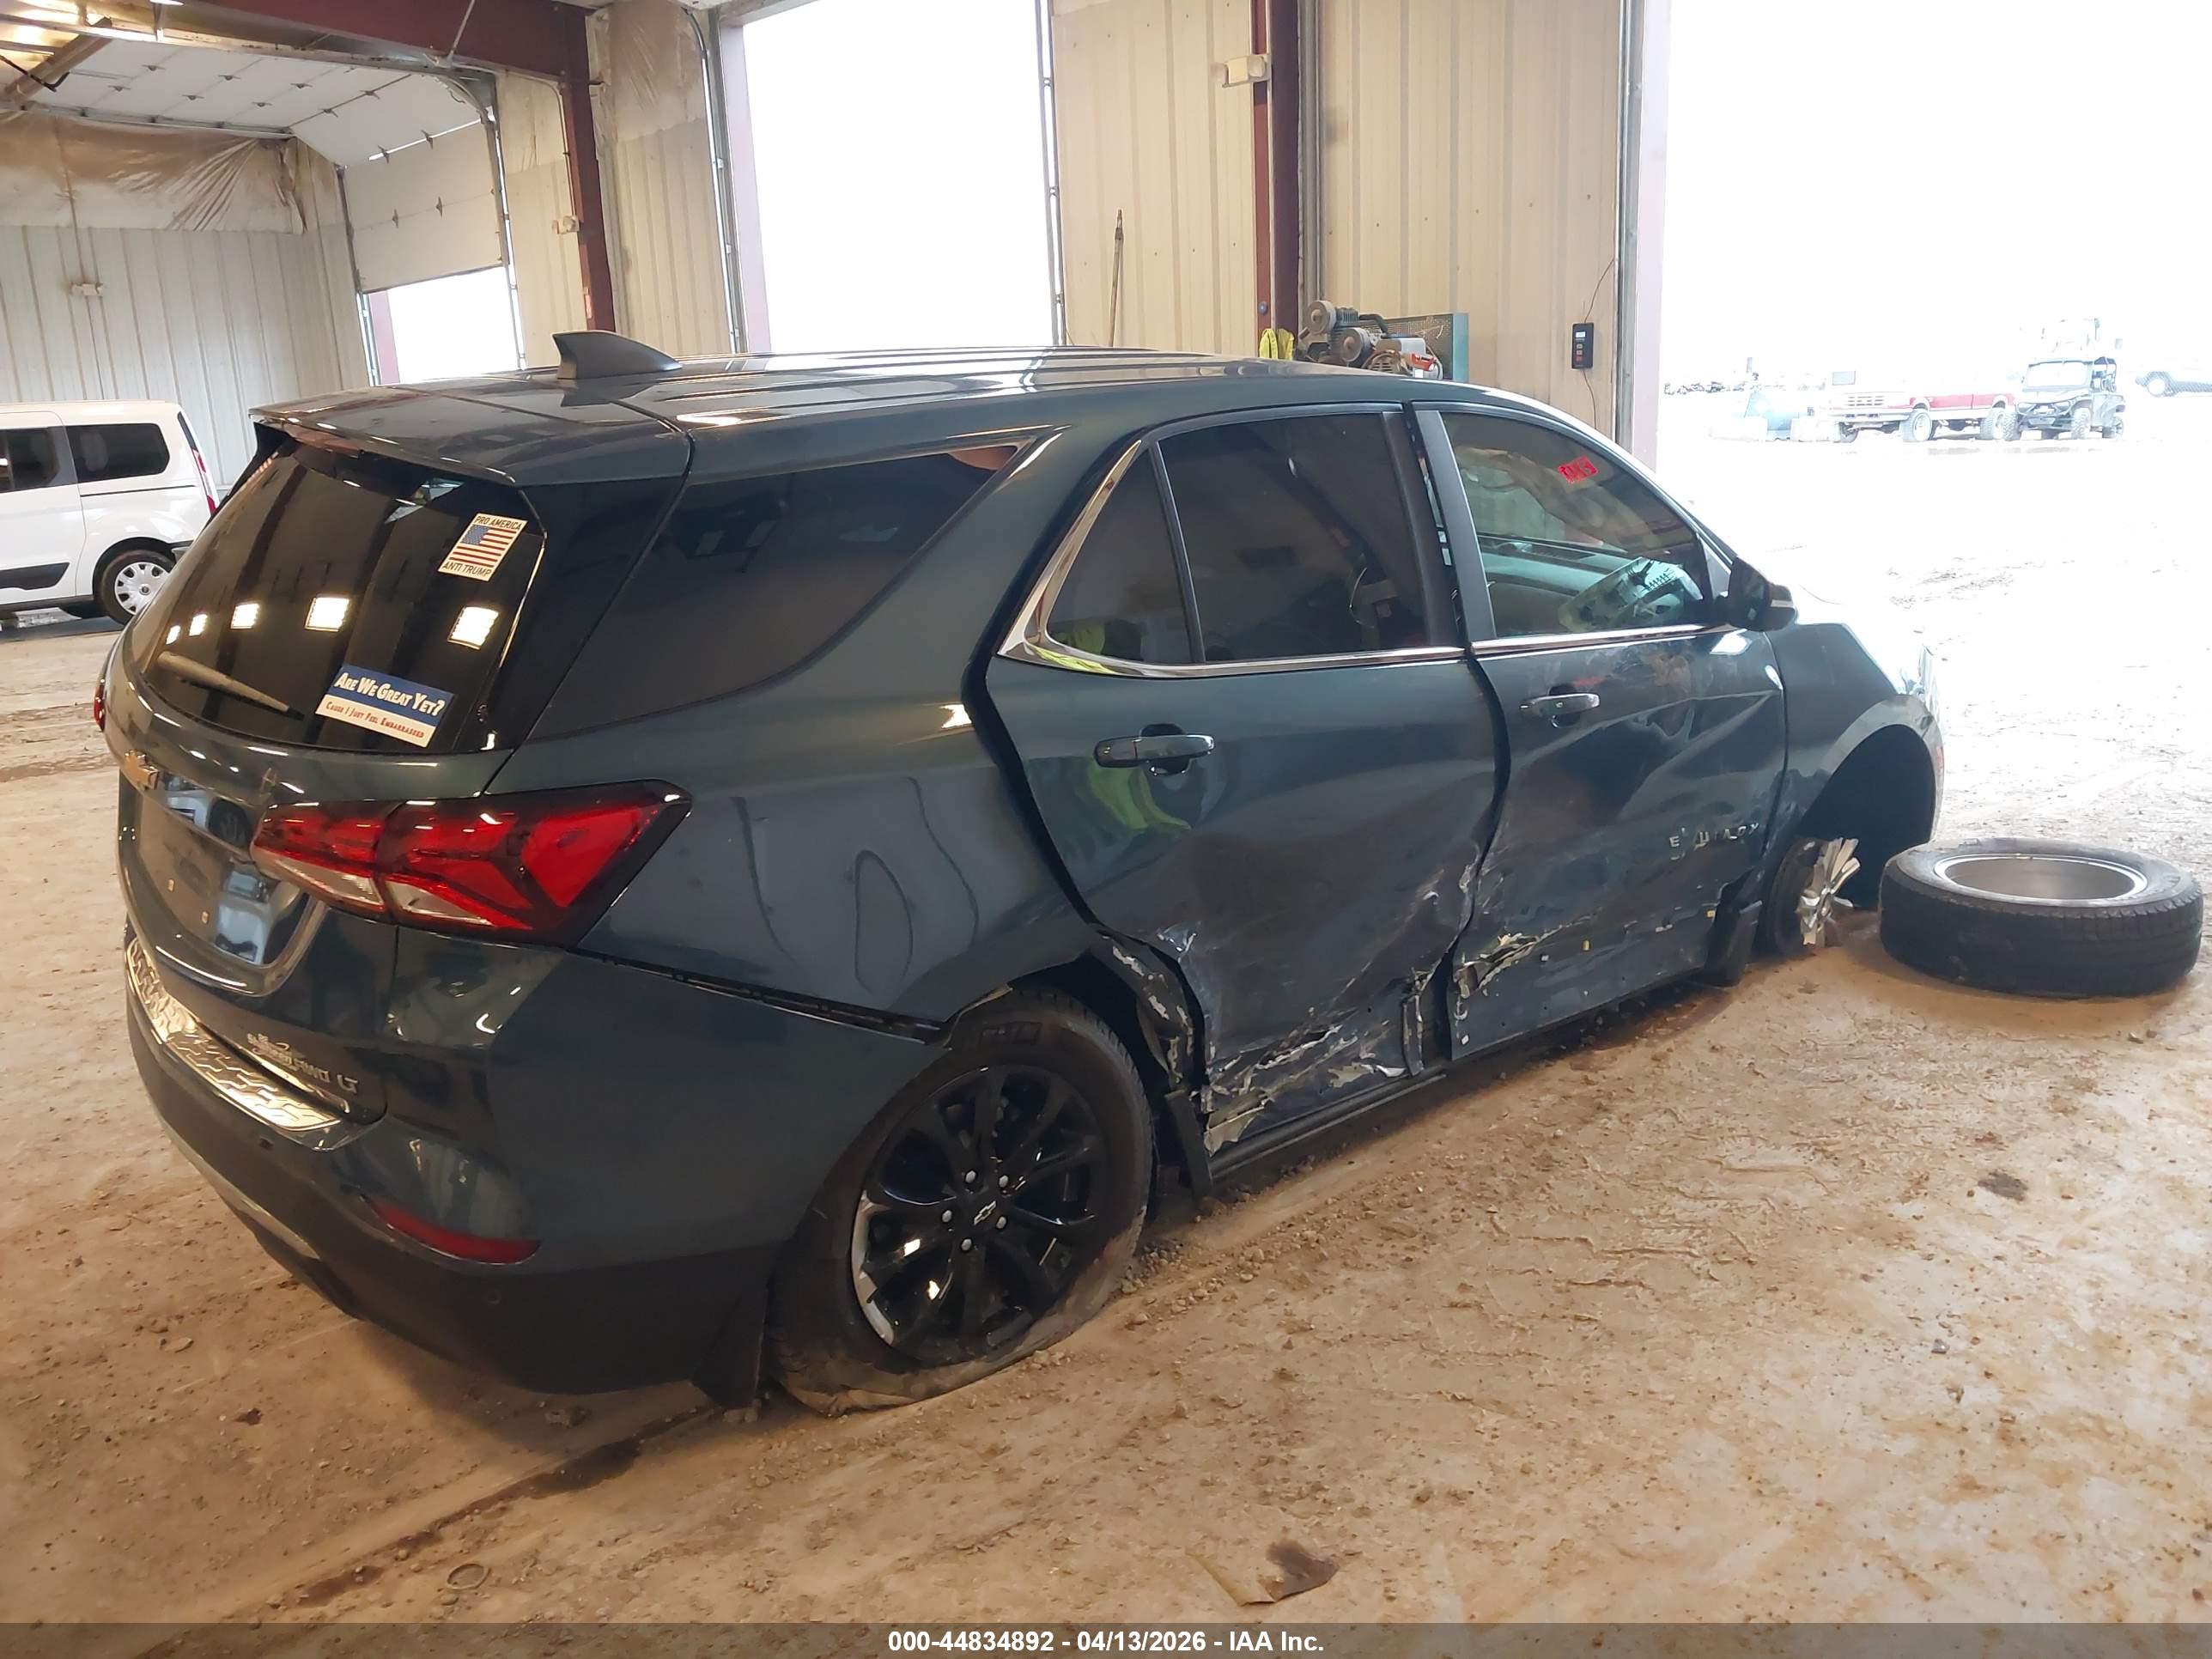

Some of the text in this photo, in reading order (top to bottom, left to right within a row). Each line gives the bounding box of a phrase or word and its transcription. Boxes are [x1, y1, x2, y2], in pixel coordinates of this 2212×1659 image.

[474, 516, 522, 530] PRO AMERICA
[442, 562, 492, 576] ANTI TRUMP
